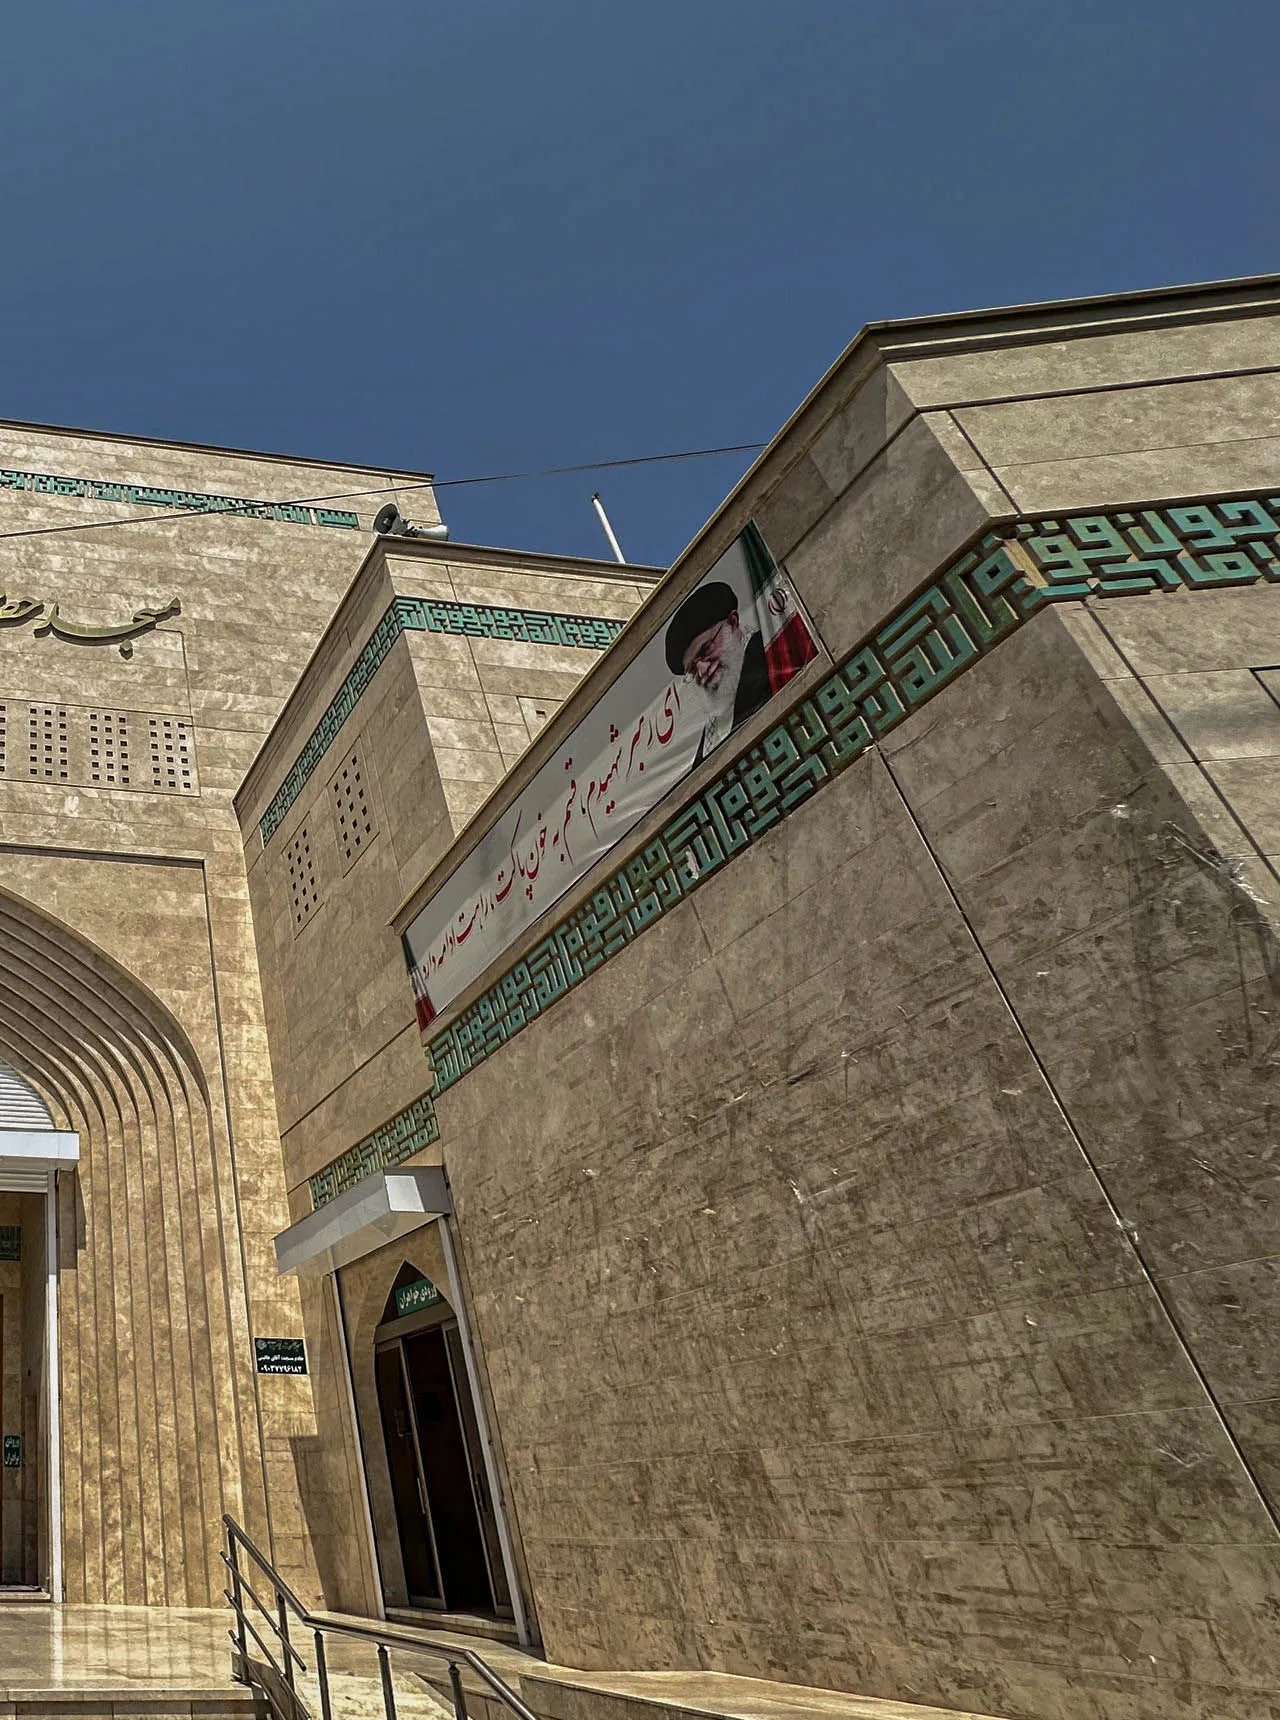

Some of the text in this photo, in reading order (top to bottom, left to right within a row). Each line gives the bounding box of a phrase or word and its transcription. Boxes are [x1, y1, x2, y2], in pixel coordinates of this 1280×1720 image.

[34, 596, 181, 660] مسجد
[656, 681, 681, 744] ای
[626, 716, 653, 779] رهبر
[563, 757, 577, 866] قسم
[526, 812, 548, 881] خون
[552, 829, 565, 862] به
[437, 925, 456, 967] ادامه
[456, 891, 488, 944] راهت
[422, 951, 436, 980] دارد
[399, 1286, 419, 1309] خواهران
